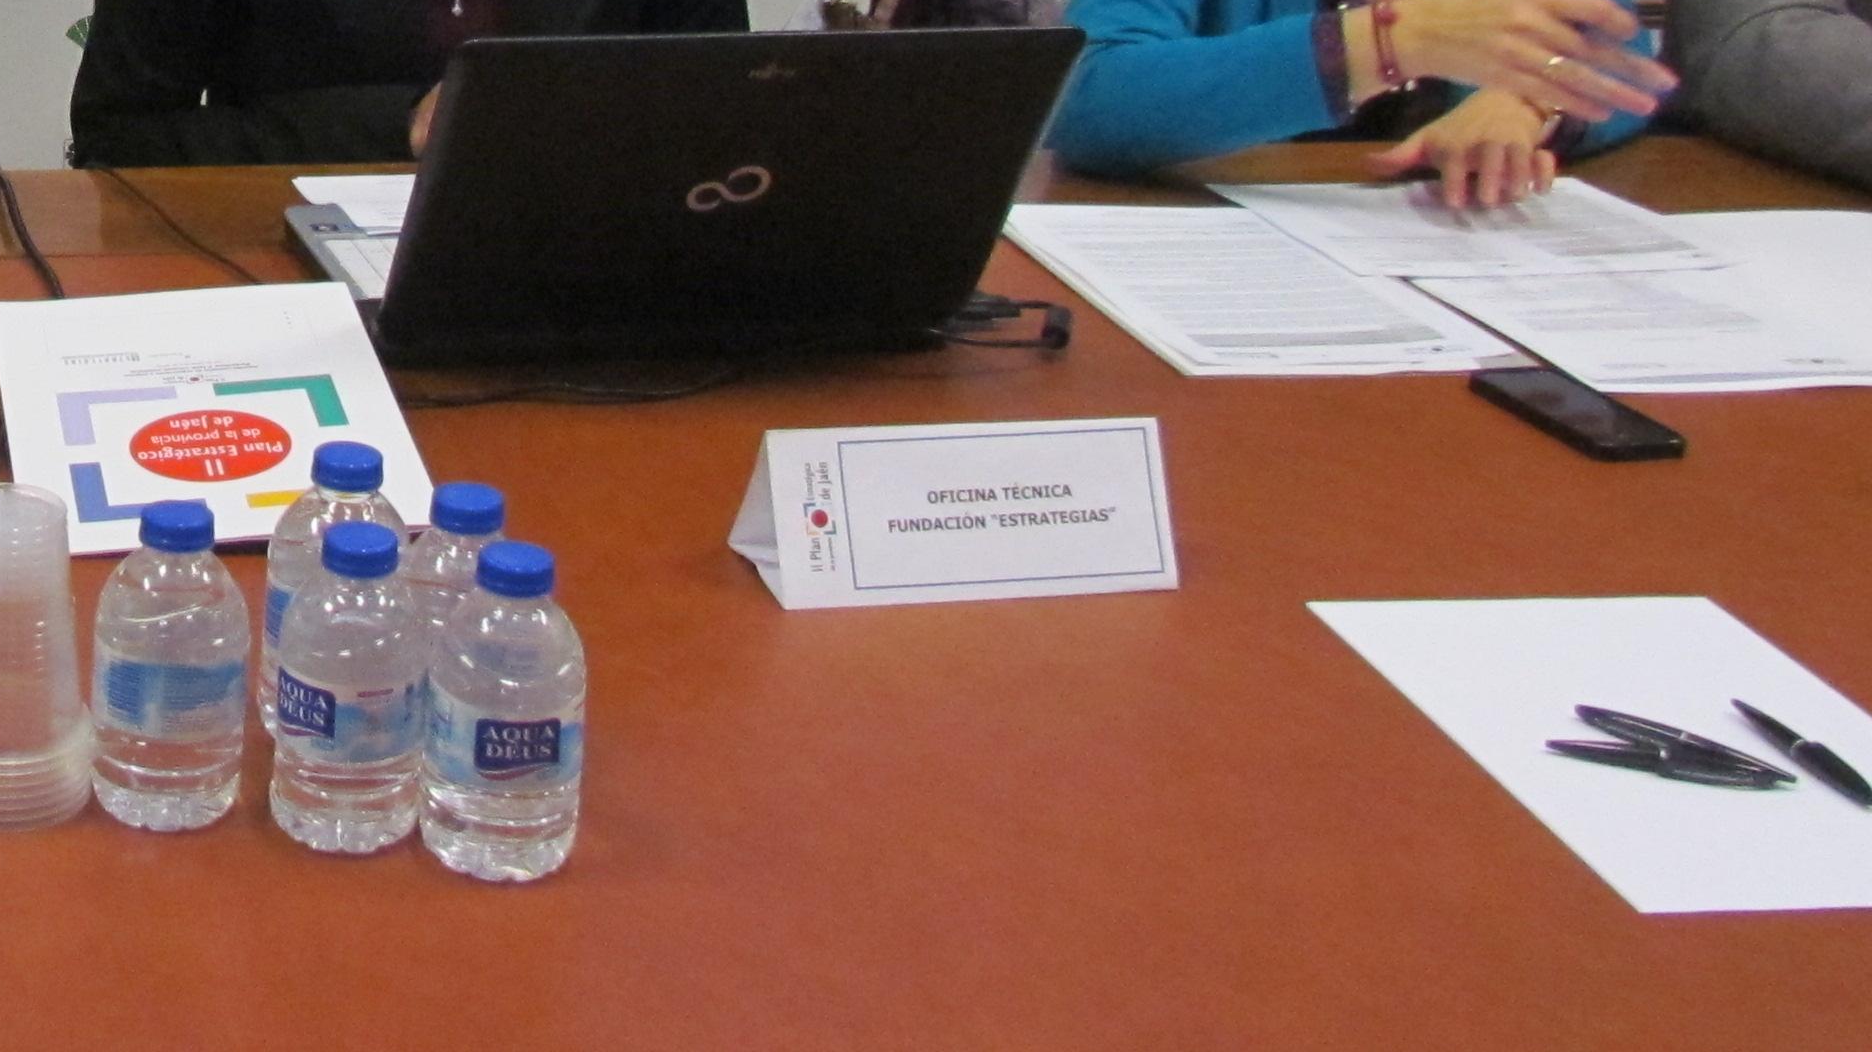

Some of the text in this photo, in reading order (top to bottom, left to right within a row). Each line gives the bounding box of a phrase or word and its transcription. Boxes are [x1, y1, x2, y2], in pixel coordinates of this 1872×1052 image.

[170, 415, 234, 430] de Jaén
[150, 428, 261, 445] de la provincia
[137, 441, 284, 462] Plan Estratégico
[927, 483, 1072, 504] OFICINA TÉCNICA
[888, 513, 986, 533] FUNDACIÓN
[809, 537, 822, 561] Plan
[280, 676, 327, 710] AQUA
[483, 725, 555, 745] AQUA
[485, 742, 552, 760] DEUS
